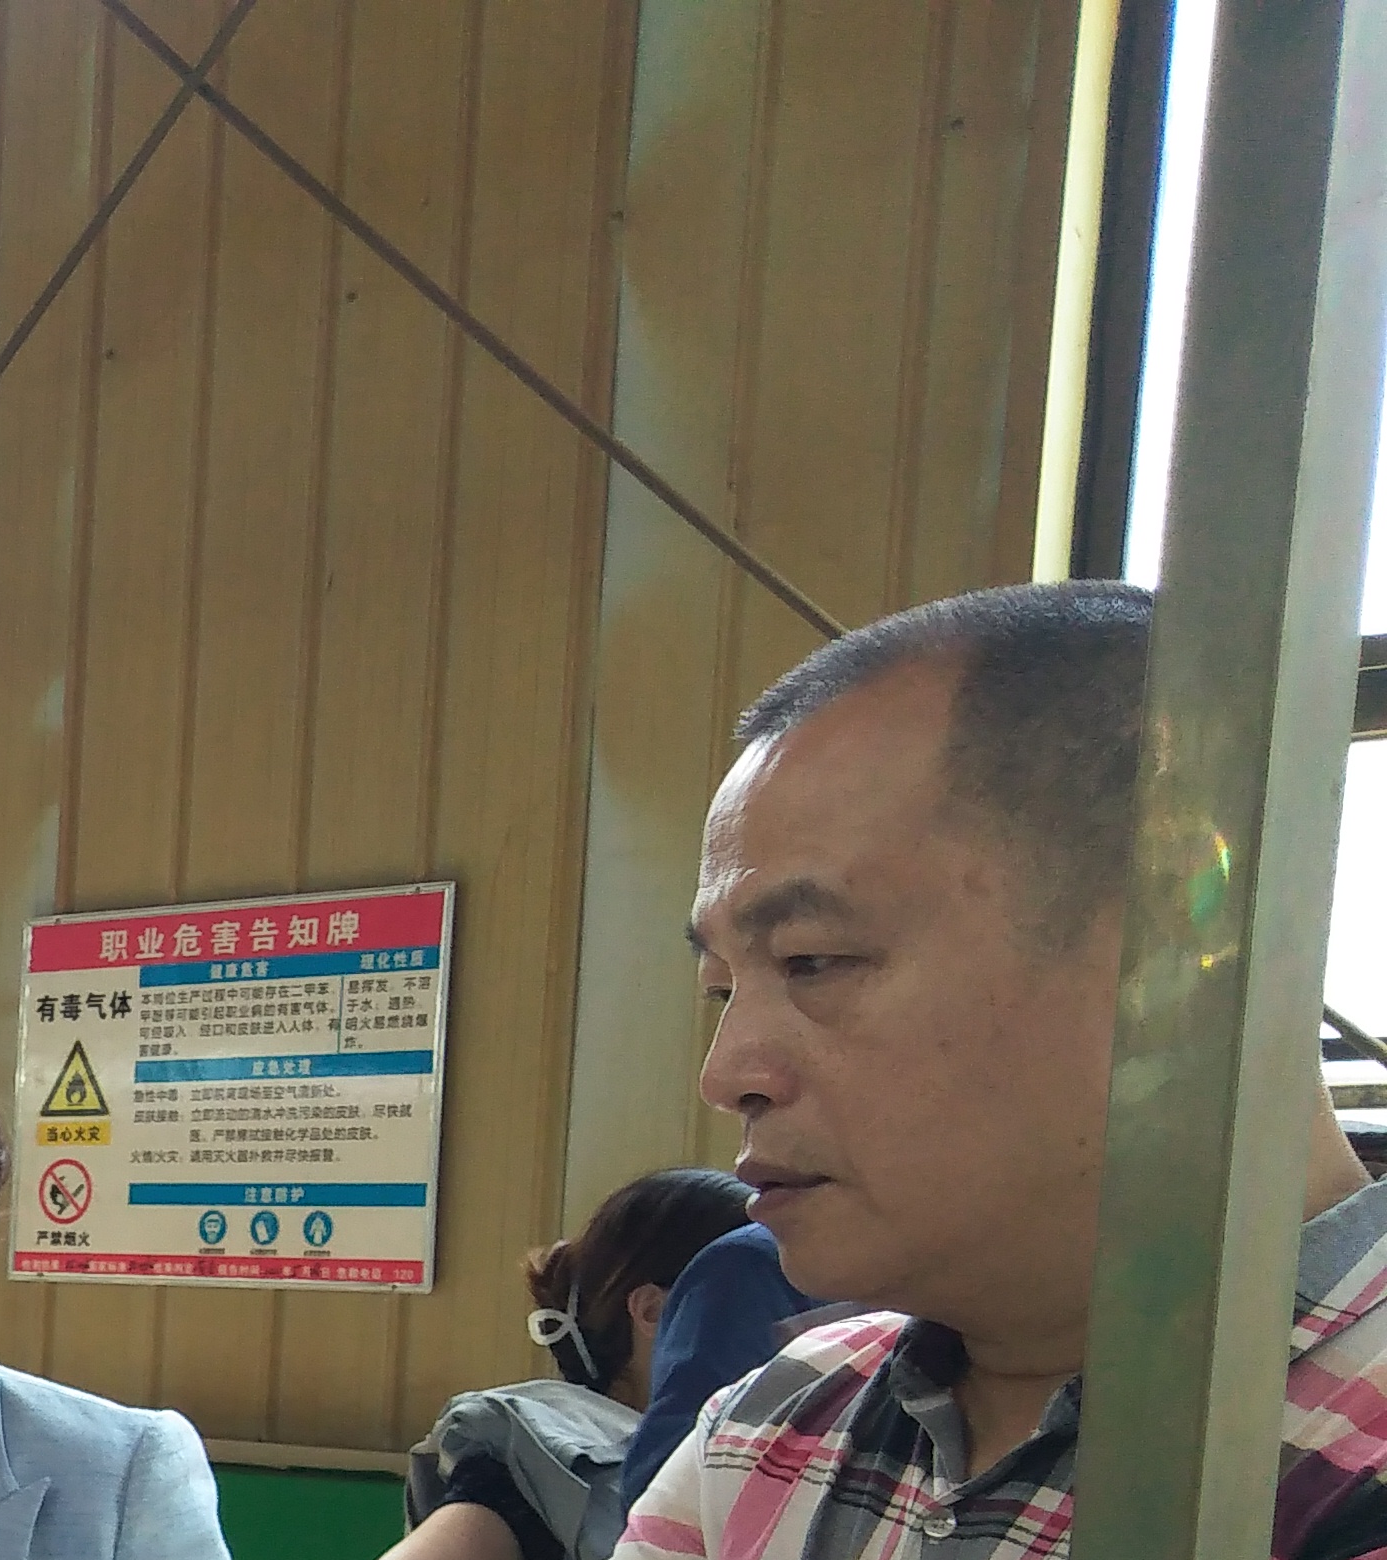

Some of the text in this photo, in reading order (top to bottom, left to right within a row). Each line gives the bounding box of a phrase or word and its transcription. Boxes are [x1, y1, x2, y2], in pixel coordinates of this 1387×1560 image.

[99, 911, 361, 961] 职业危害告知牌
[35, 991, 133, 1022] 有毒气体
[45, 1126, 101, 1143] 当心火灾
[35, 1230, 91, 1248] 严禁烟火
[392, 1268, 414, 1281] 120
